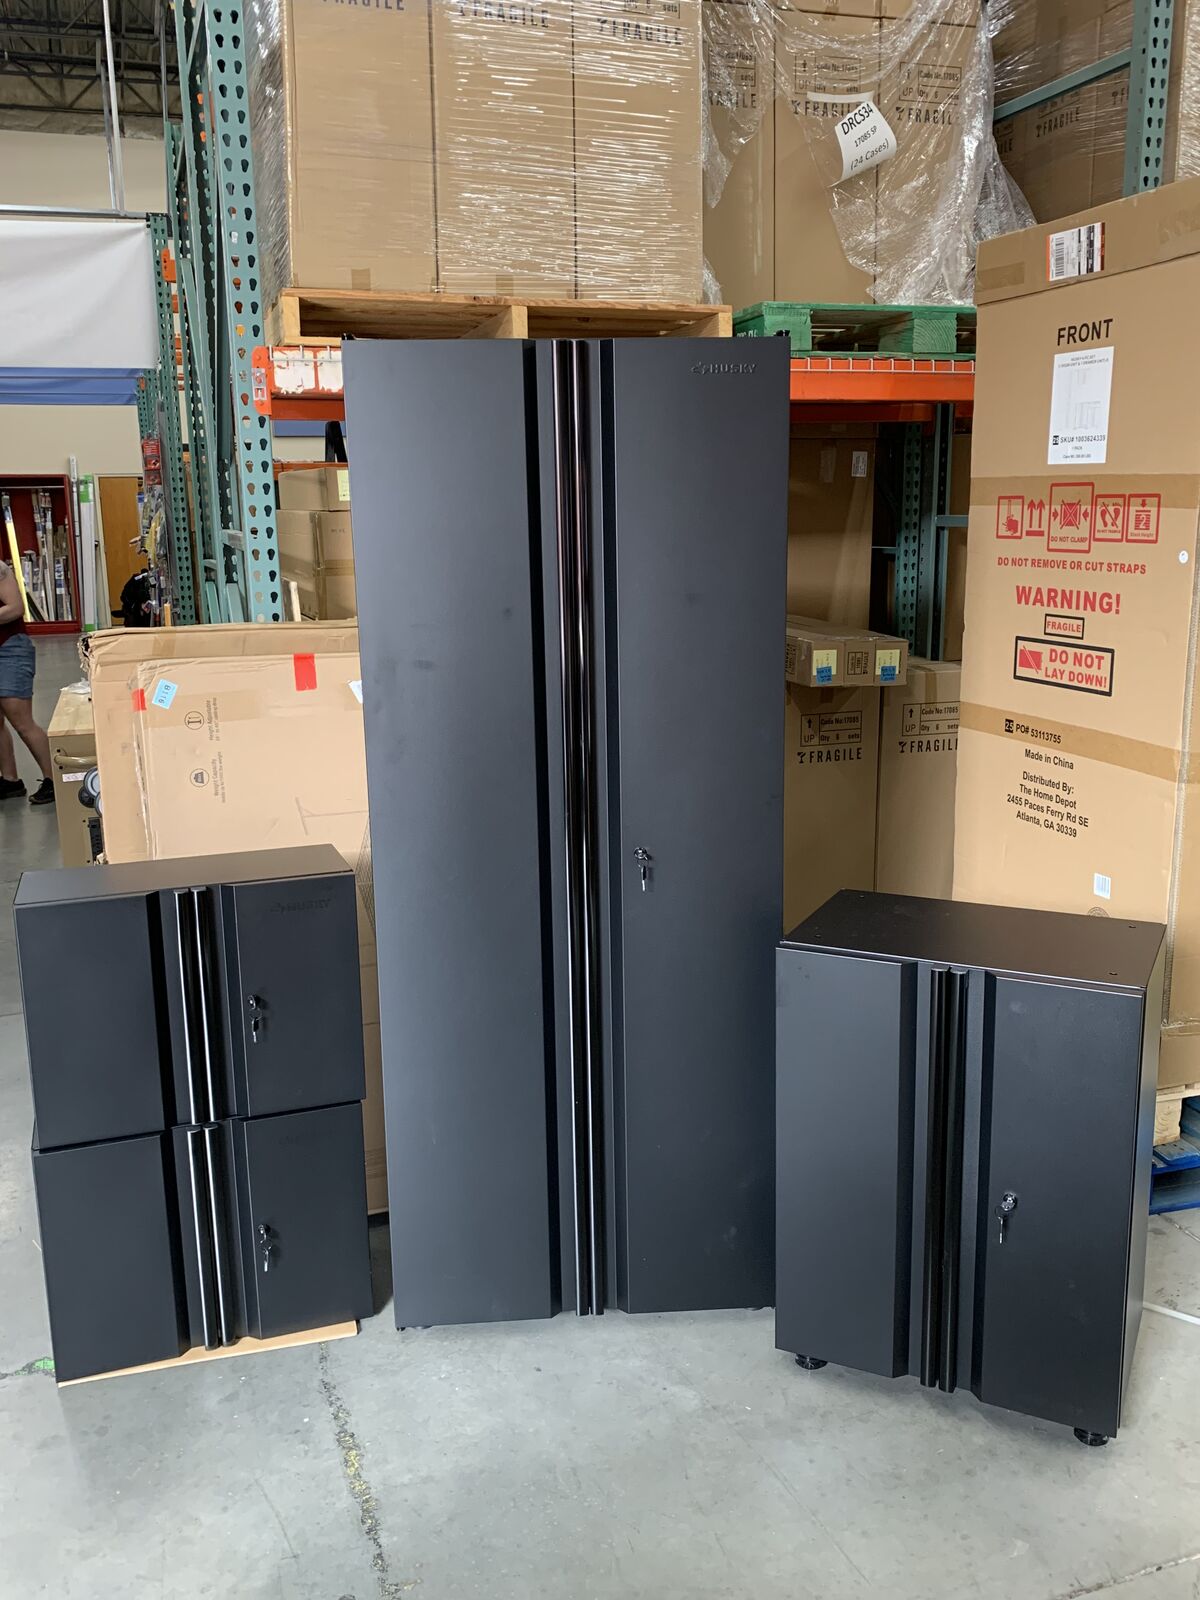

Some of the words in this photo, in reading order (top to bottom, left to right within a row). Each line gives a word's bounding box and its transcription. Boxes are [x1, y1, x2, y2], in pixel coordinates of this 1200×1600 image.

[805, 101, 861, 117] FRAGIL
[841, 103, 874, 136] DRCS34
[1043, 106, 1081, 136] FRAGILE
[854, 130, 871, 148] 17085
[850, 155, 864, 171] (24
[865, 138, 890, 161] Cases)
[1057, 318, 1113, 346] FRONT
[709, 362, 757, 374] HUSKY
[1060, 436, 1075, 444] SKU#
[997, 557, 1009, 567] DO
[1011, 557, 1029, 568] NOT
[1031, 558, 1067, 570] REMOVE
[1069, 560, 1082, 571] OR
[1085, 561, 1104, 572] CUT
[1106, 562, 1146, 575] STRAPS
[1015, 585, 1121, 615] WARNING!
[1046, 620, 1082, 633] FRAGILE
[1049, 648, 1069, 665] DO
[1073, 652, 1104, 671] NOT
[1045, 667, 1065, 681] LAY
[1068, 671, 1107, 688] DOWN!
[804, 734, 815, 743] UP
[905, 724, 916, 733] UP
[1016, 723, 1030, 734] PO#
[1031, 728, 1062, 744] 53113755
[809, 747, 862, 764] FRAGILE
[1025, 748, 1043, 762] Made
[1044, 753, 1052, 764] in
[1052, 755, 1074, 770] China
[1022, 770, 1060, 790] Distributed
[1062, 782, 1074, 795] By:
[1020, 783, 1032, 795] The
[1033, 787, 1054, 802] Home
[1055, 794, 1077, 809] Depot
[1007, 793, 1023, 806] 2455
[1024, 798, 1045, 813] Paces
[1046, 805, 1065, 821] Ferry
[1066, 812, 1077, 824] Rd
[1078, 816, 1089, 827] SE
[1016, 810, 1042, 828] Atlanta,
[1043, 819, 1055, 830] GA
[1056, 823, 1077, 838] 30339
